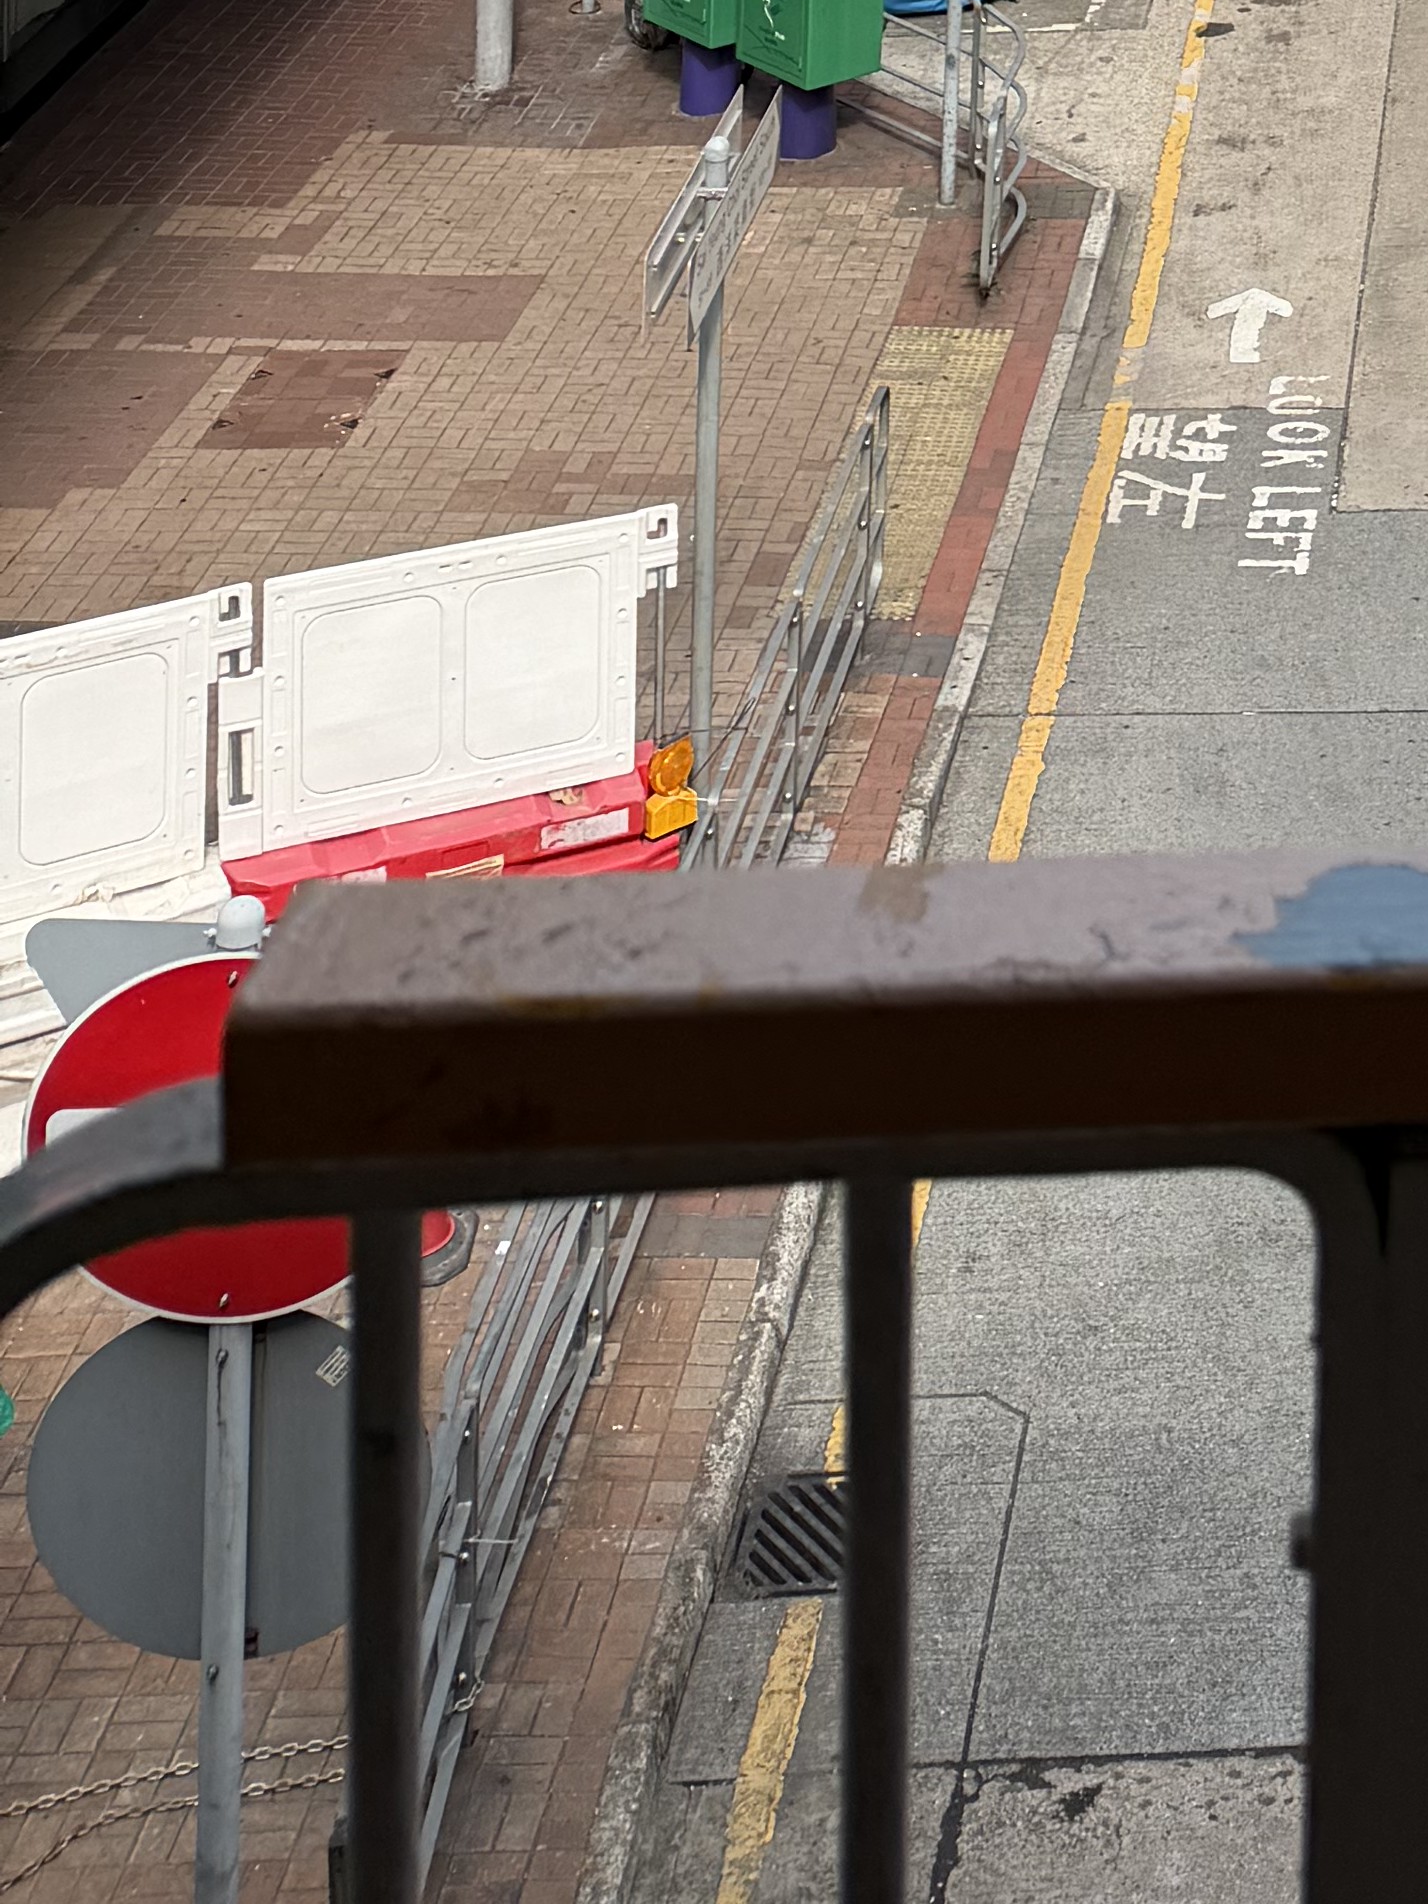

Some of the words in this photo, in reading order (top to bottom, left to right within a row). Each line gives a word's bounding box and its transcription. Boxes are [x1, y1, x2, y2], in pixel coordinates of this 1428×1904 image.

[1106, 410, 1226, 532] 望左
[1259, 375, 1331, 473] LOOK
[1235, 482, 1319, 577] LEFT
